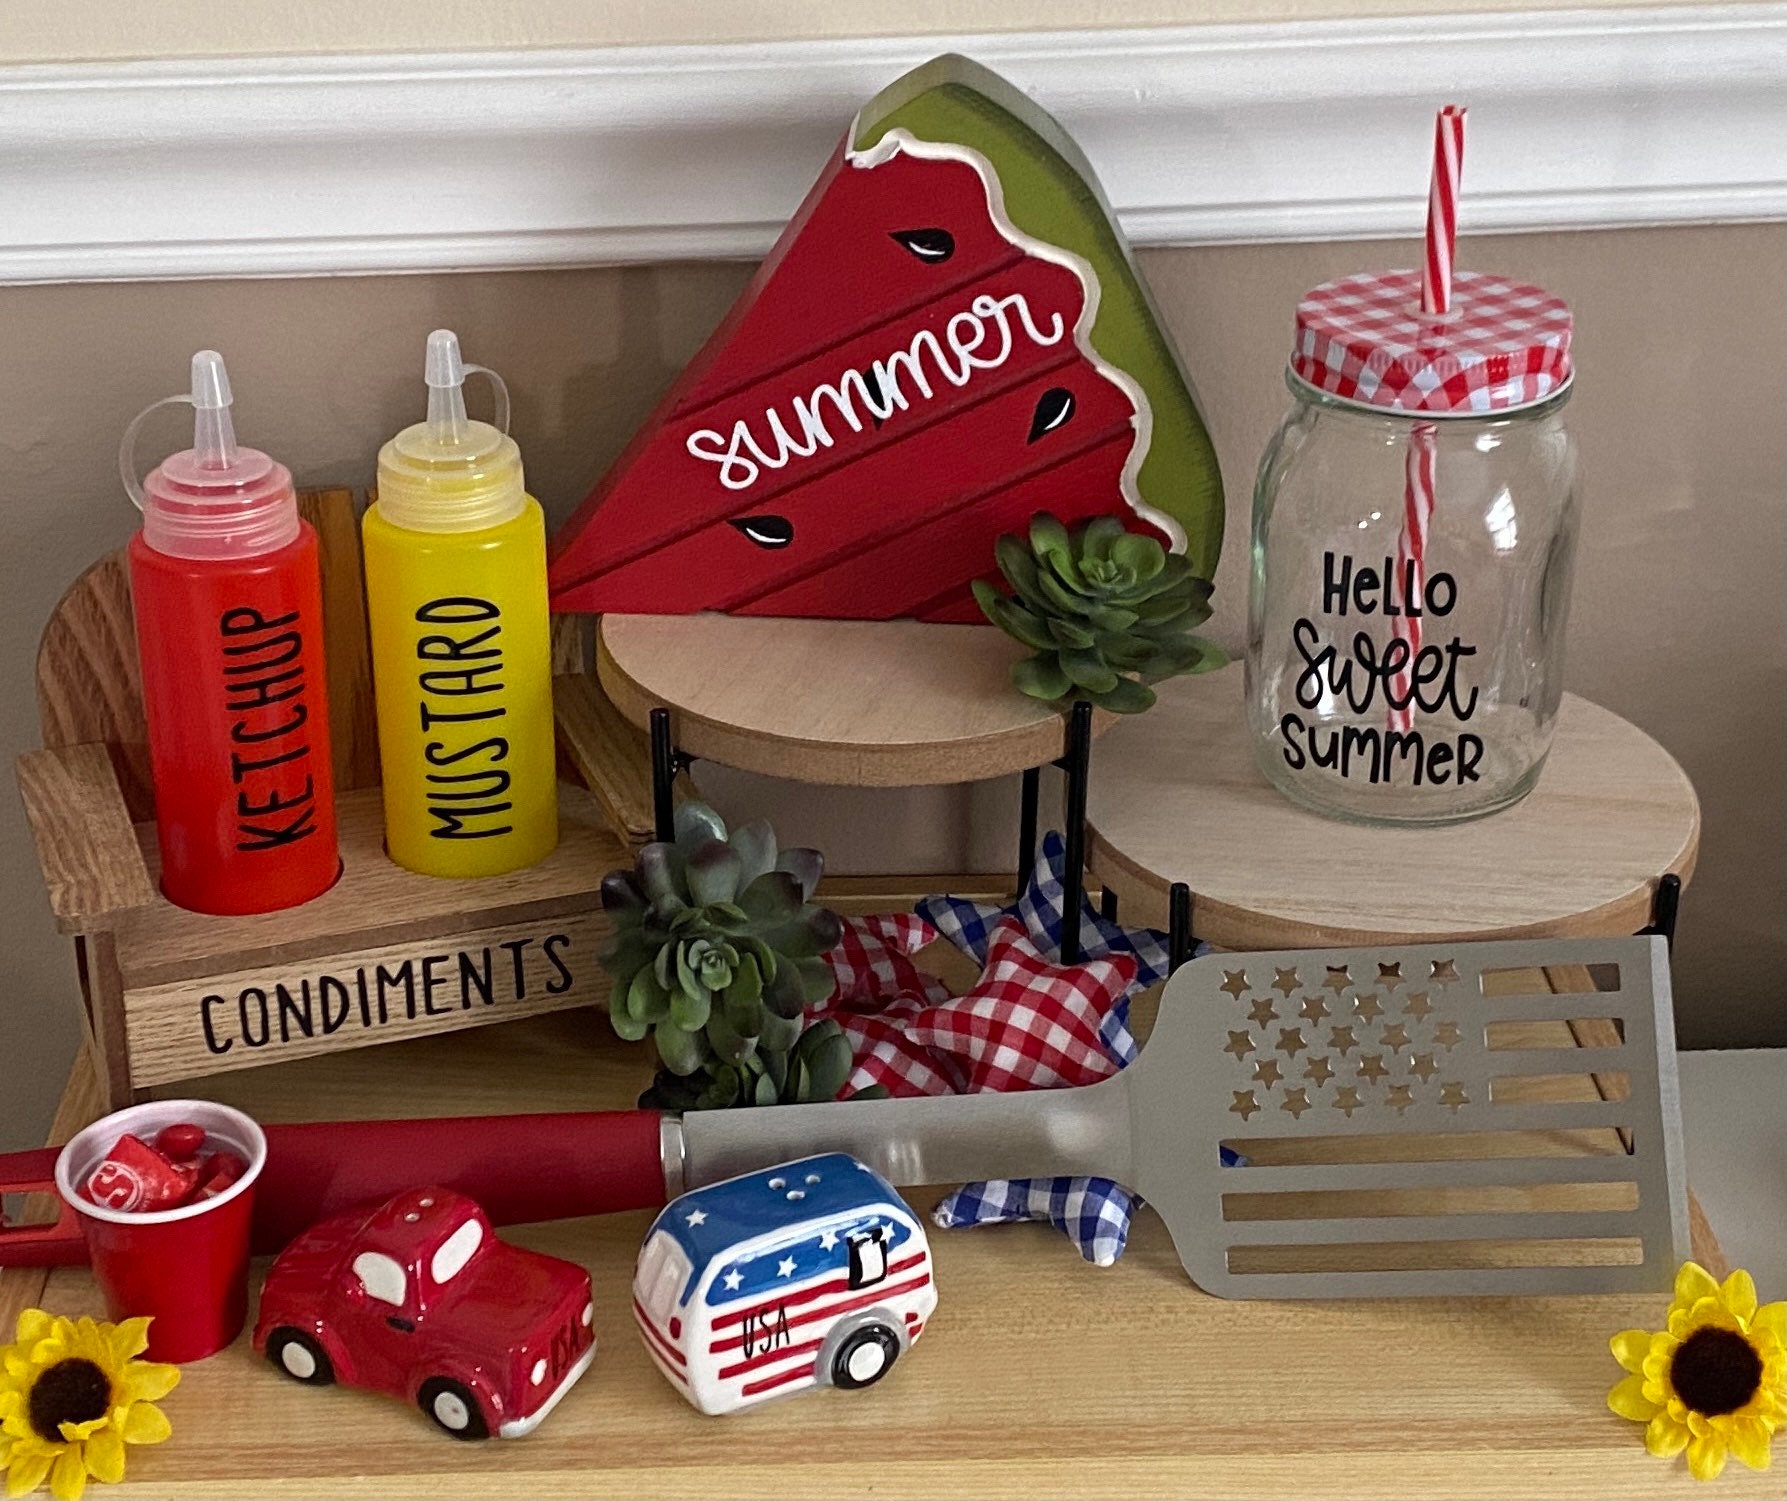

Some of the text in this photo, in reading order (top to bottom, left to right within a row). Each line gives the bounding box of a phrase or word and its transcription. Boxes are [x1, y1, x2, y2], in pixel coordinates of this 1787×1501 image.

[686, 293, 1064, 490] summer
[220, 606, 318, 851] KETCHUP
[415, 597, 513, 839] MUSTARD
[1293, 617, 1479, 721] Sweet
[201, 934, 574, 1054] CONDIMENTS
[551, 1315, 580, 1380] USA
[742, 1304, 790, 1359] USA
